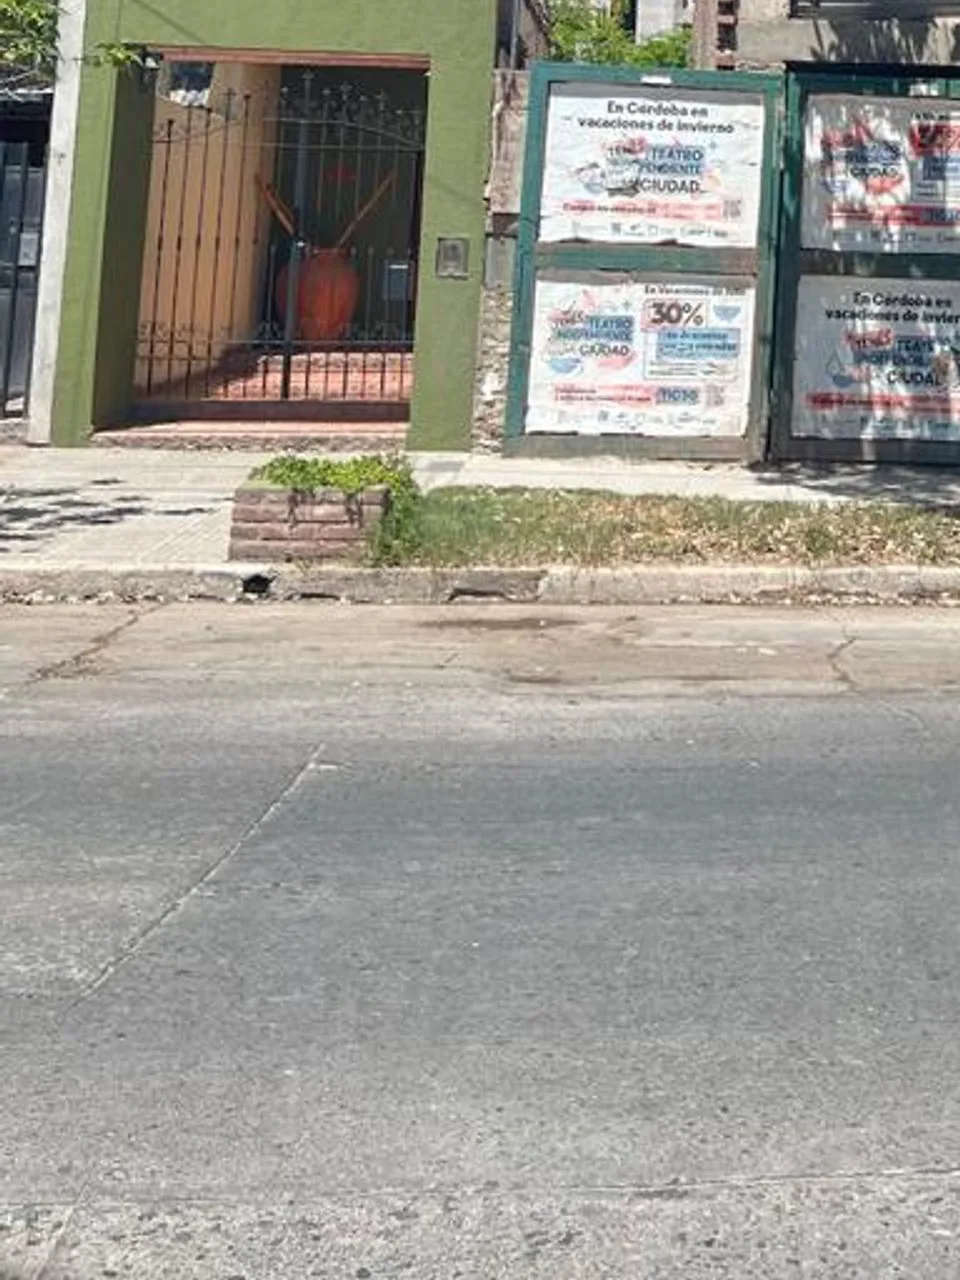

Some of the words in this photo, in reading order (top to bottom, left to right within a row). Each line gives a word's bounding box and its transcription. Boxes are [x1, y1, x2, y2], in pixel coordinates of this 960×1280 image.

[607, 100, 623, 114] En
[627, 101, 688, 117] Córdoba
[690, 106, 708, 117] en
[578, 117, 653, 131] vacaciones
[657, 119, 673, 131] de
[677, 120, 734, 134] invierno
[651, 148, 704, 161] TEATRO
[640, 179, 700, 194] CIUDAD
[853, 292, 870, 305] En
[935, 297, 952, 308] en
[650, 302, 704, 326] 30%
[826, 308, 898, 321] vacaciones
[902, 310, 918, 321] de
